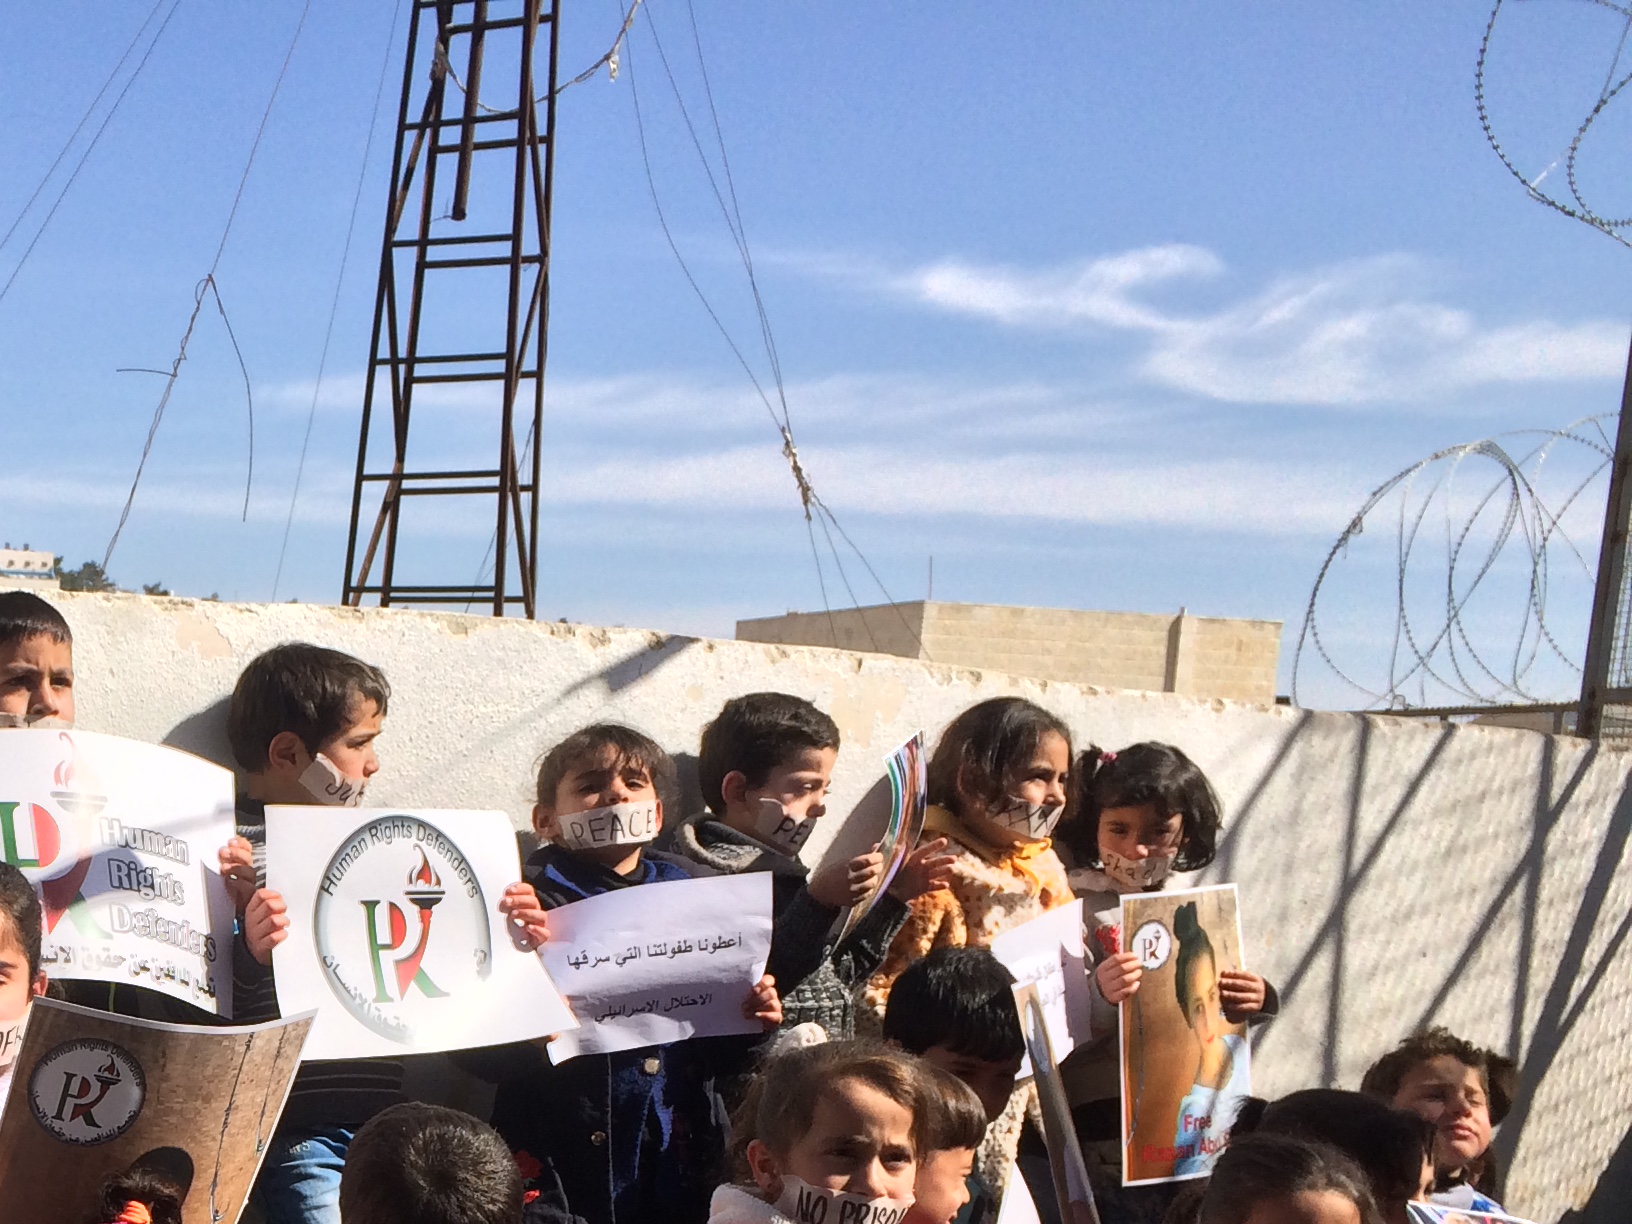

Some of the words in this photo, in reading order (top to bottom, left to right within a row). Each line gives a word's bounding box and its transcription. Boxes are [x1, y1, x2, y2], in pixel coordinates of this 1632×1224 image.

[99, 817, 190, 866] Human
[570, 808, 653, 847] PEACE
[320, 836, 368, 896] Human
[368, 819, 413, 845] Rights
[415, 823, 479, 899] Defenders
[108, 858, 185, 906] Rights
[109, 903, 216, 962] Defenders
[697, 932, 742, 954] أعطونا
[567, 949, 610, 971] سرقها
[614, 946, 642, 968] التي
[647, 939, 693, 959] طفولتنا
[663, 993, 712, 1013] الاحتلال
[79, 1040, 109, 1052] Rights
[110, 1044, 143, 1087] Defenders
[1183, 1113, 1212, 1132] Free
